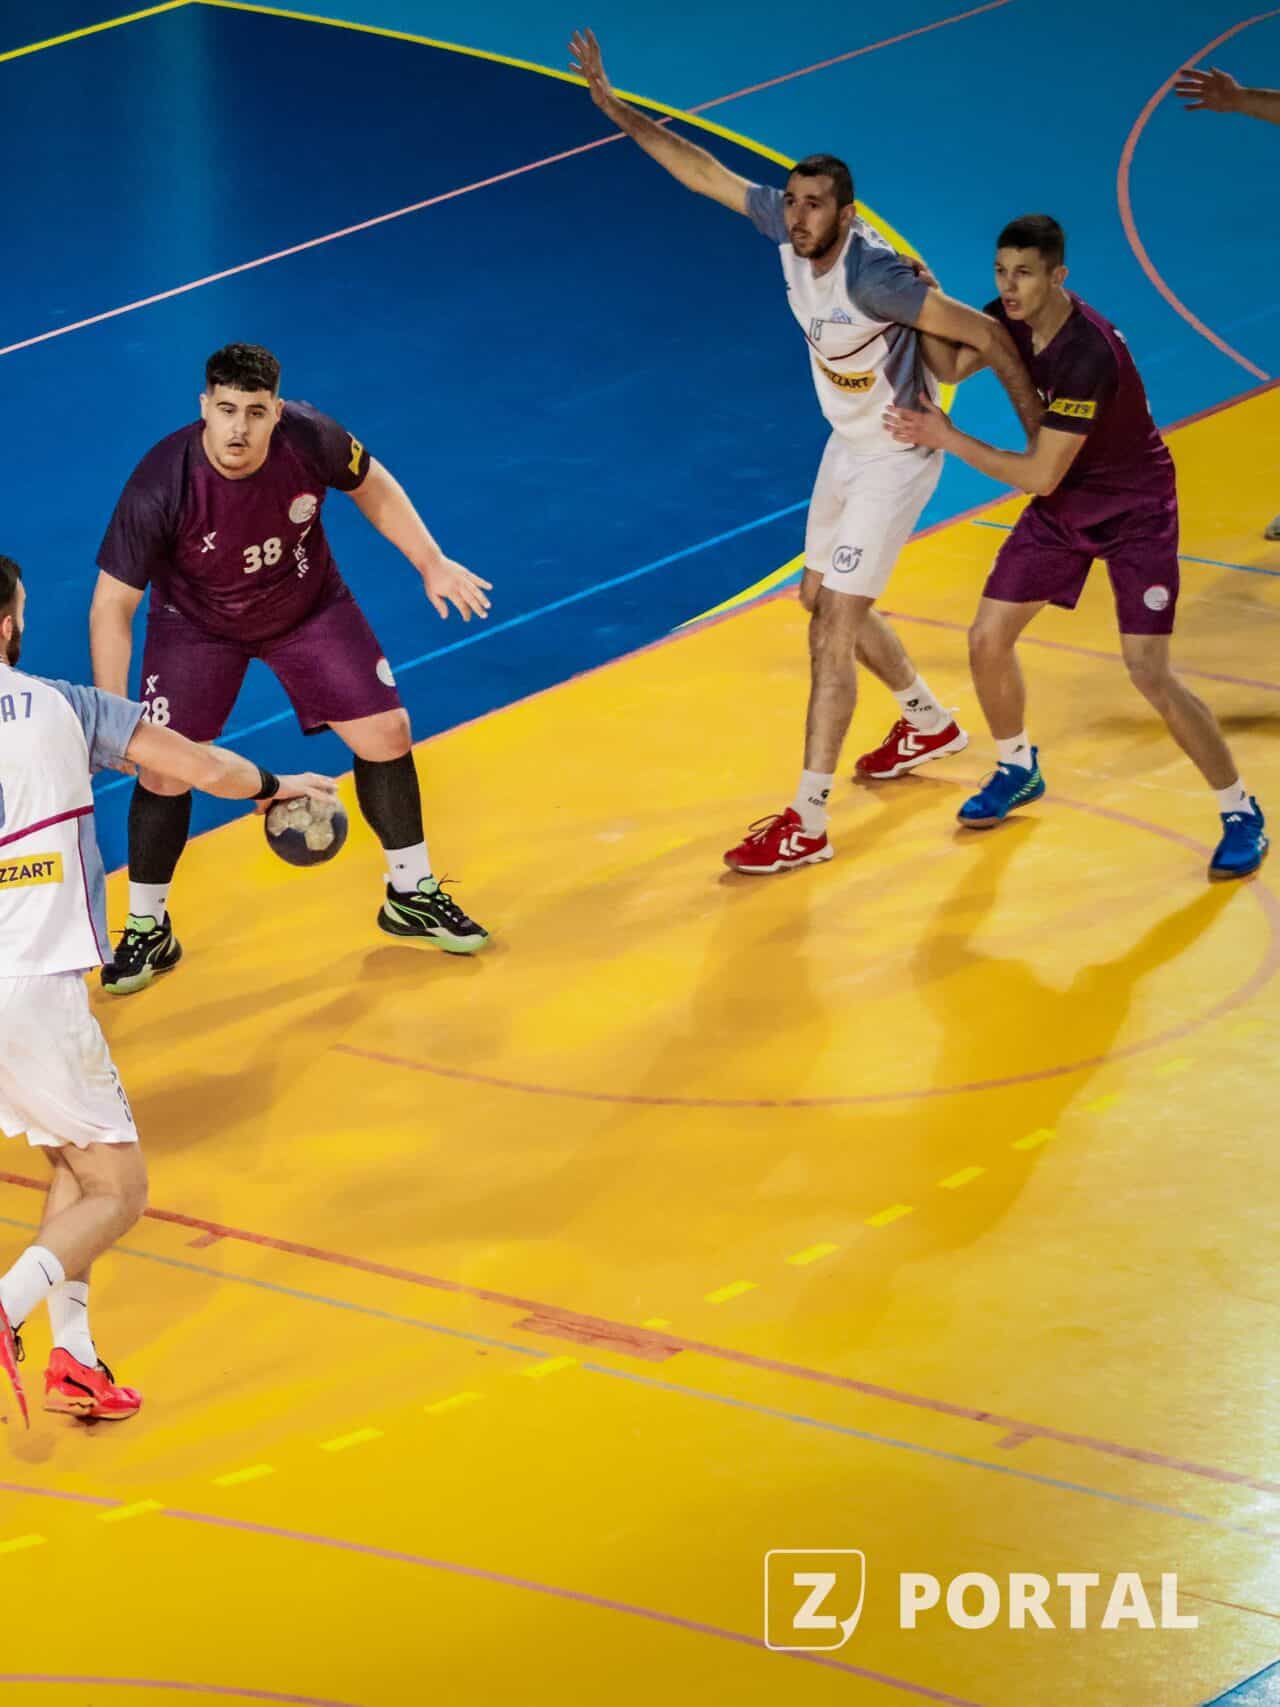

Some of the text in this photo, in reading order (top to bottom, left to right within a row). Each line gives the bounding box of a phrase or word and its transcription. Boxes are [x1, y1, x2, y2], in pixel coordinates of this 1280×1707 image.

[822, 367, 869, 388] ZZART
[243, 537, 282, 574] 38
[20, 692, 32, 718] 7
